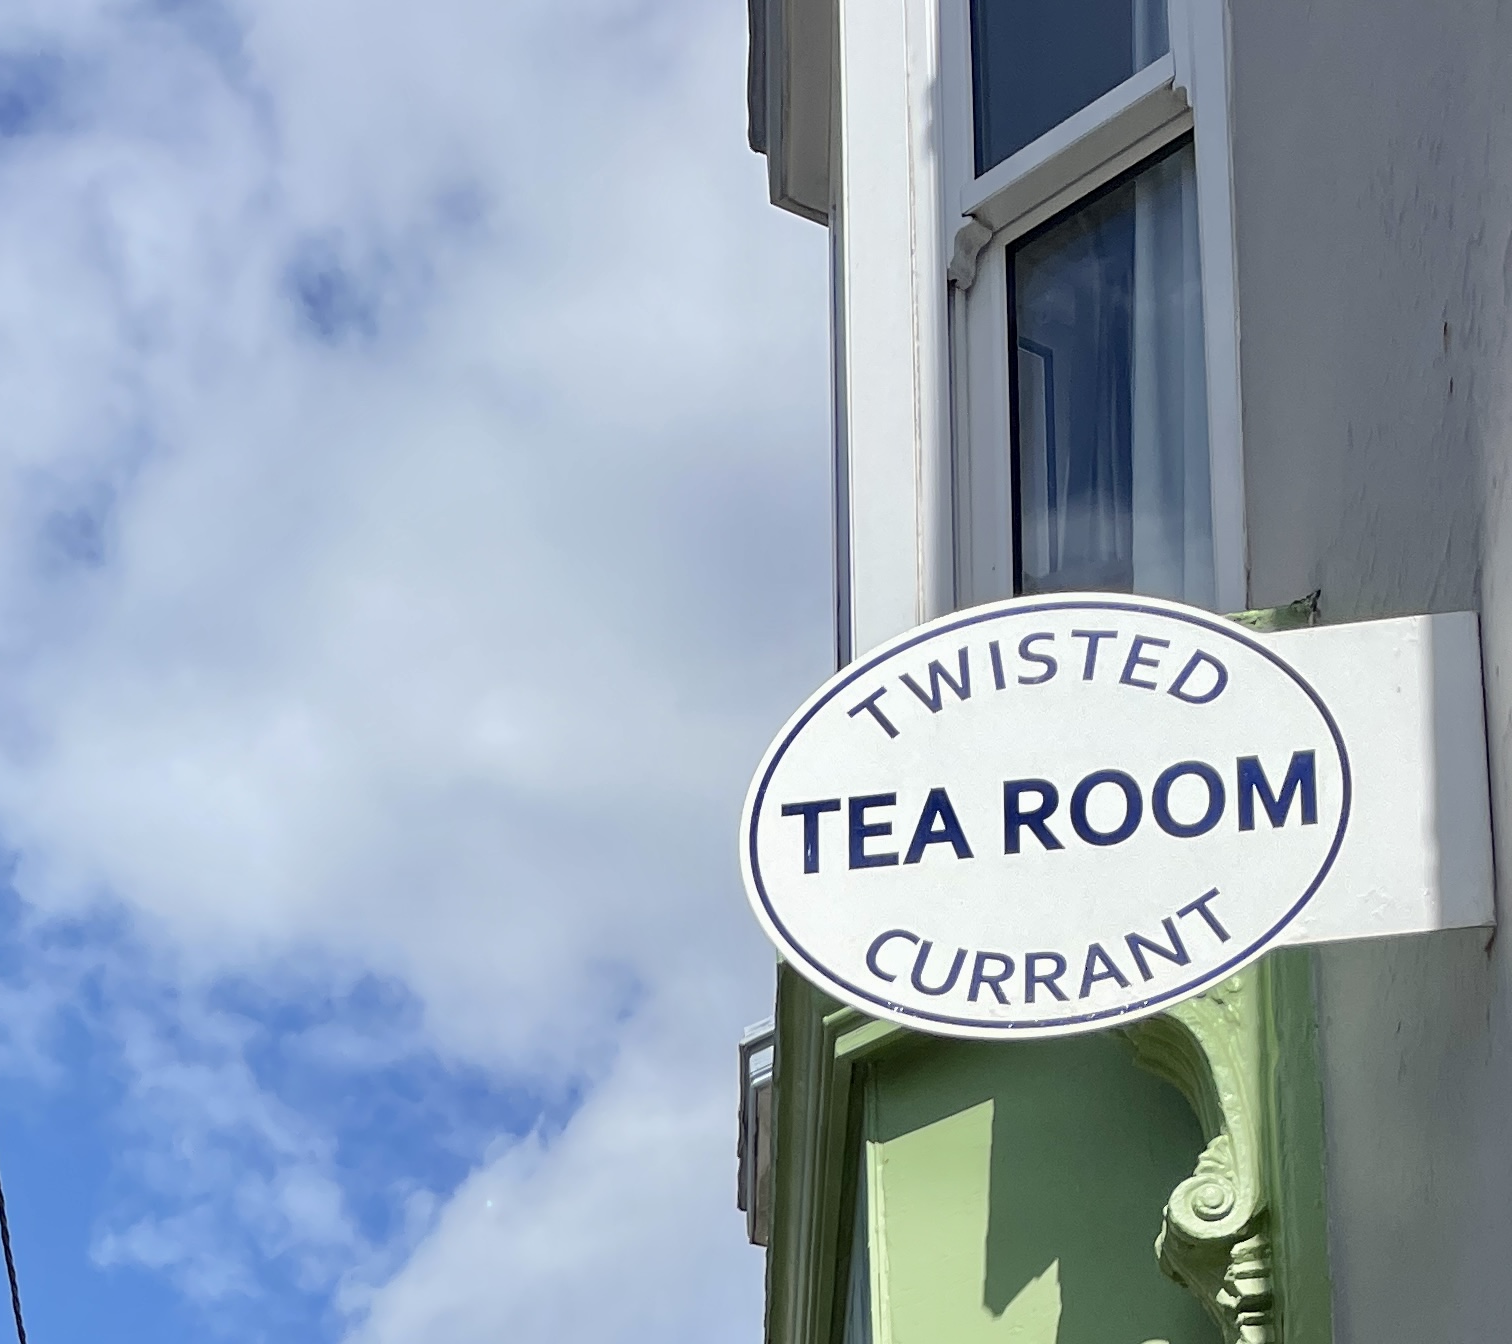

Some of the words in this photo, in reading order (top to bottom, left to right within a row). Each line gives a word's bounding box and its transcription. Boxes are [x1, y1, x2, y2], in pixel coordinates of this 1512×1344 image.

[847, 628, 1229, 739] TWISTED
[781, 787, 974, 875] TEA
[1003, 748, 1319, 856] ROOM
[864, 886, 1233, 1006] CURRANT
